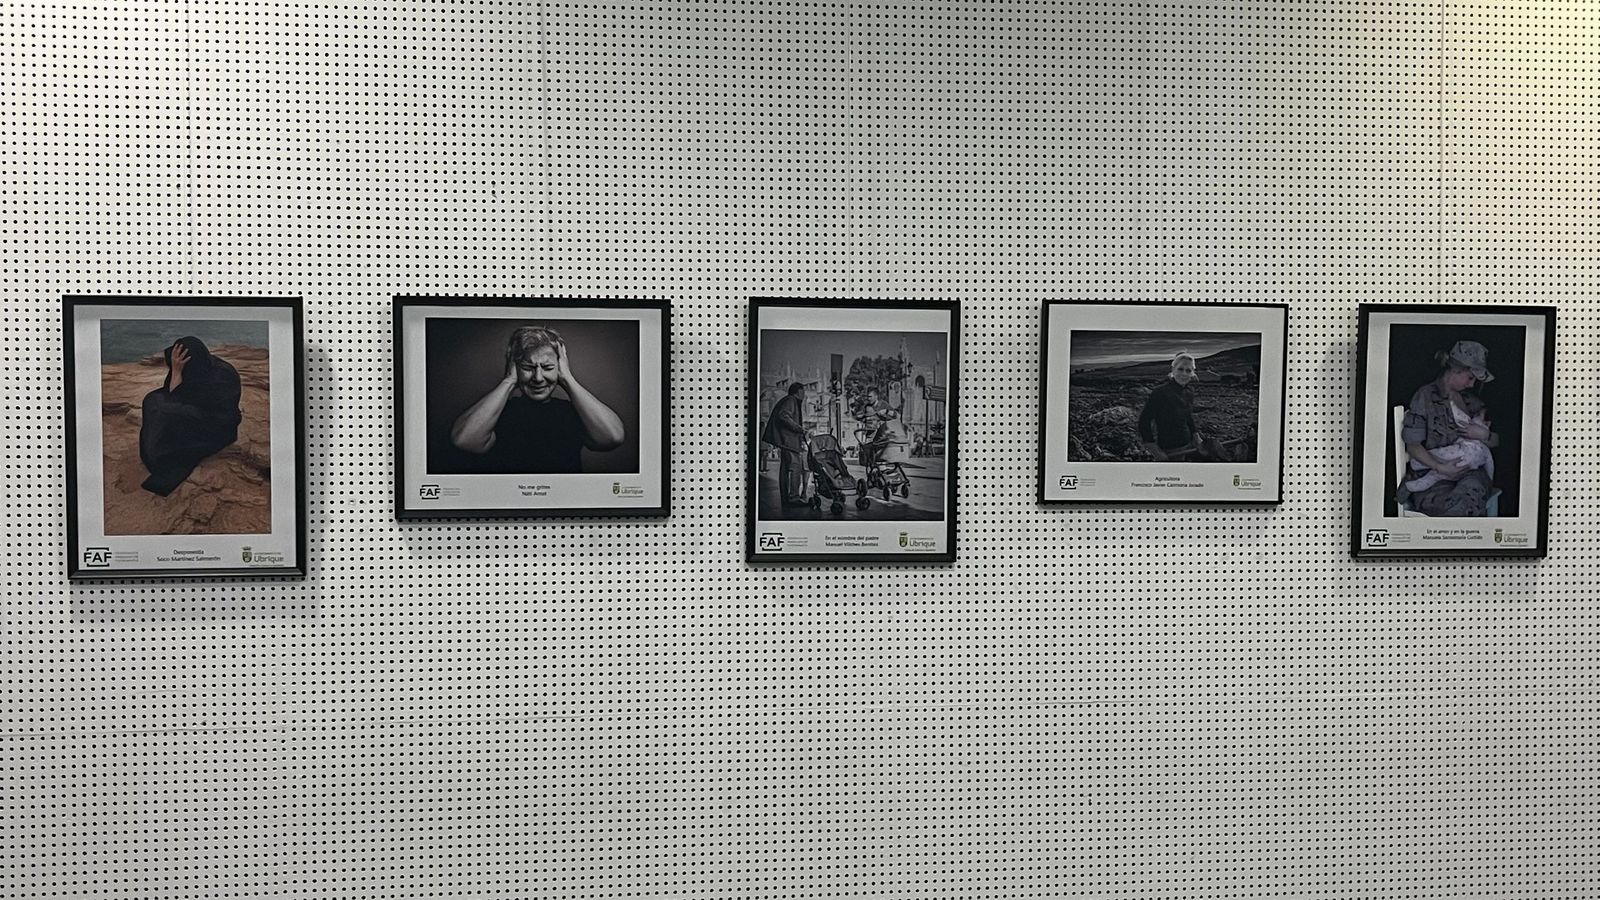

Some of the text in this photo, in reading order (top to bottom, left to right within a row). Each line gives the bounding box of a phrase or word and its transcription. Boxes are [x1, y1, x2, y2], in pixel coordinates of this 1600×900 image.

[1059, 478, 1079, 487] FAF
[419, 488, 441, 497] FAF
[621, 488, 644, 496] Ubrique
[759, 537, 785, 547] FAF
[1366, 533, 1390, 543] FAF
[1503, 535, 1529, 544] Ubrique
[909, 539, 936, 548] Ubrique
[83, 552, 112, 563] FAF
[253, 555, 284, 564] Ubrique
